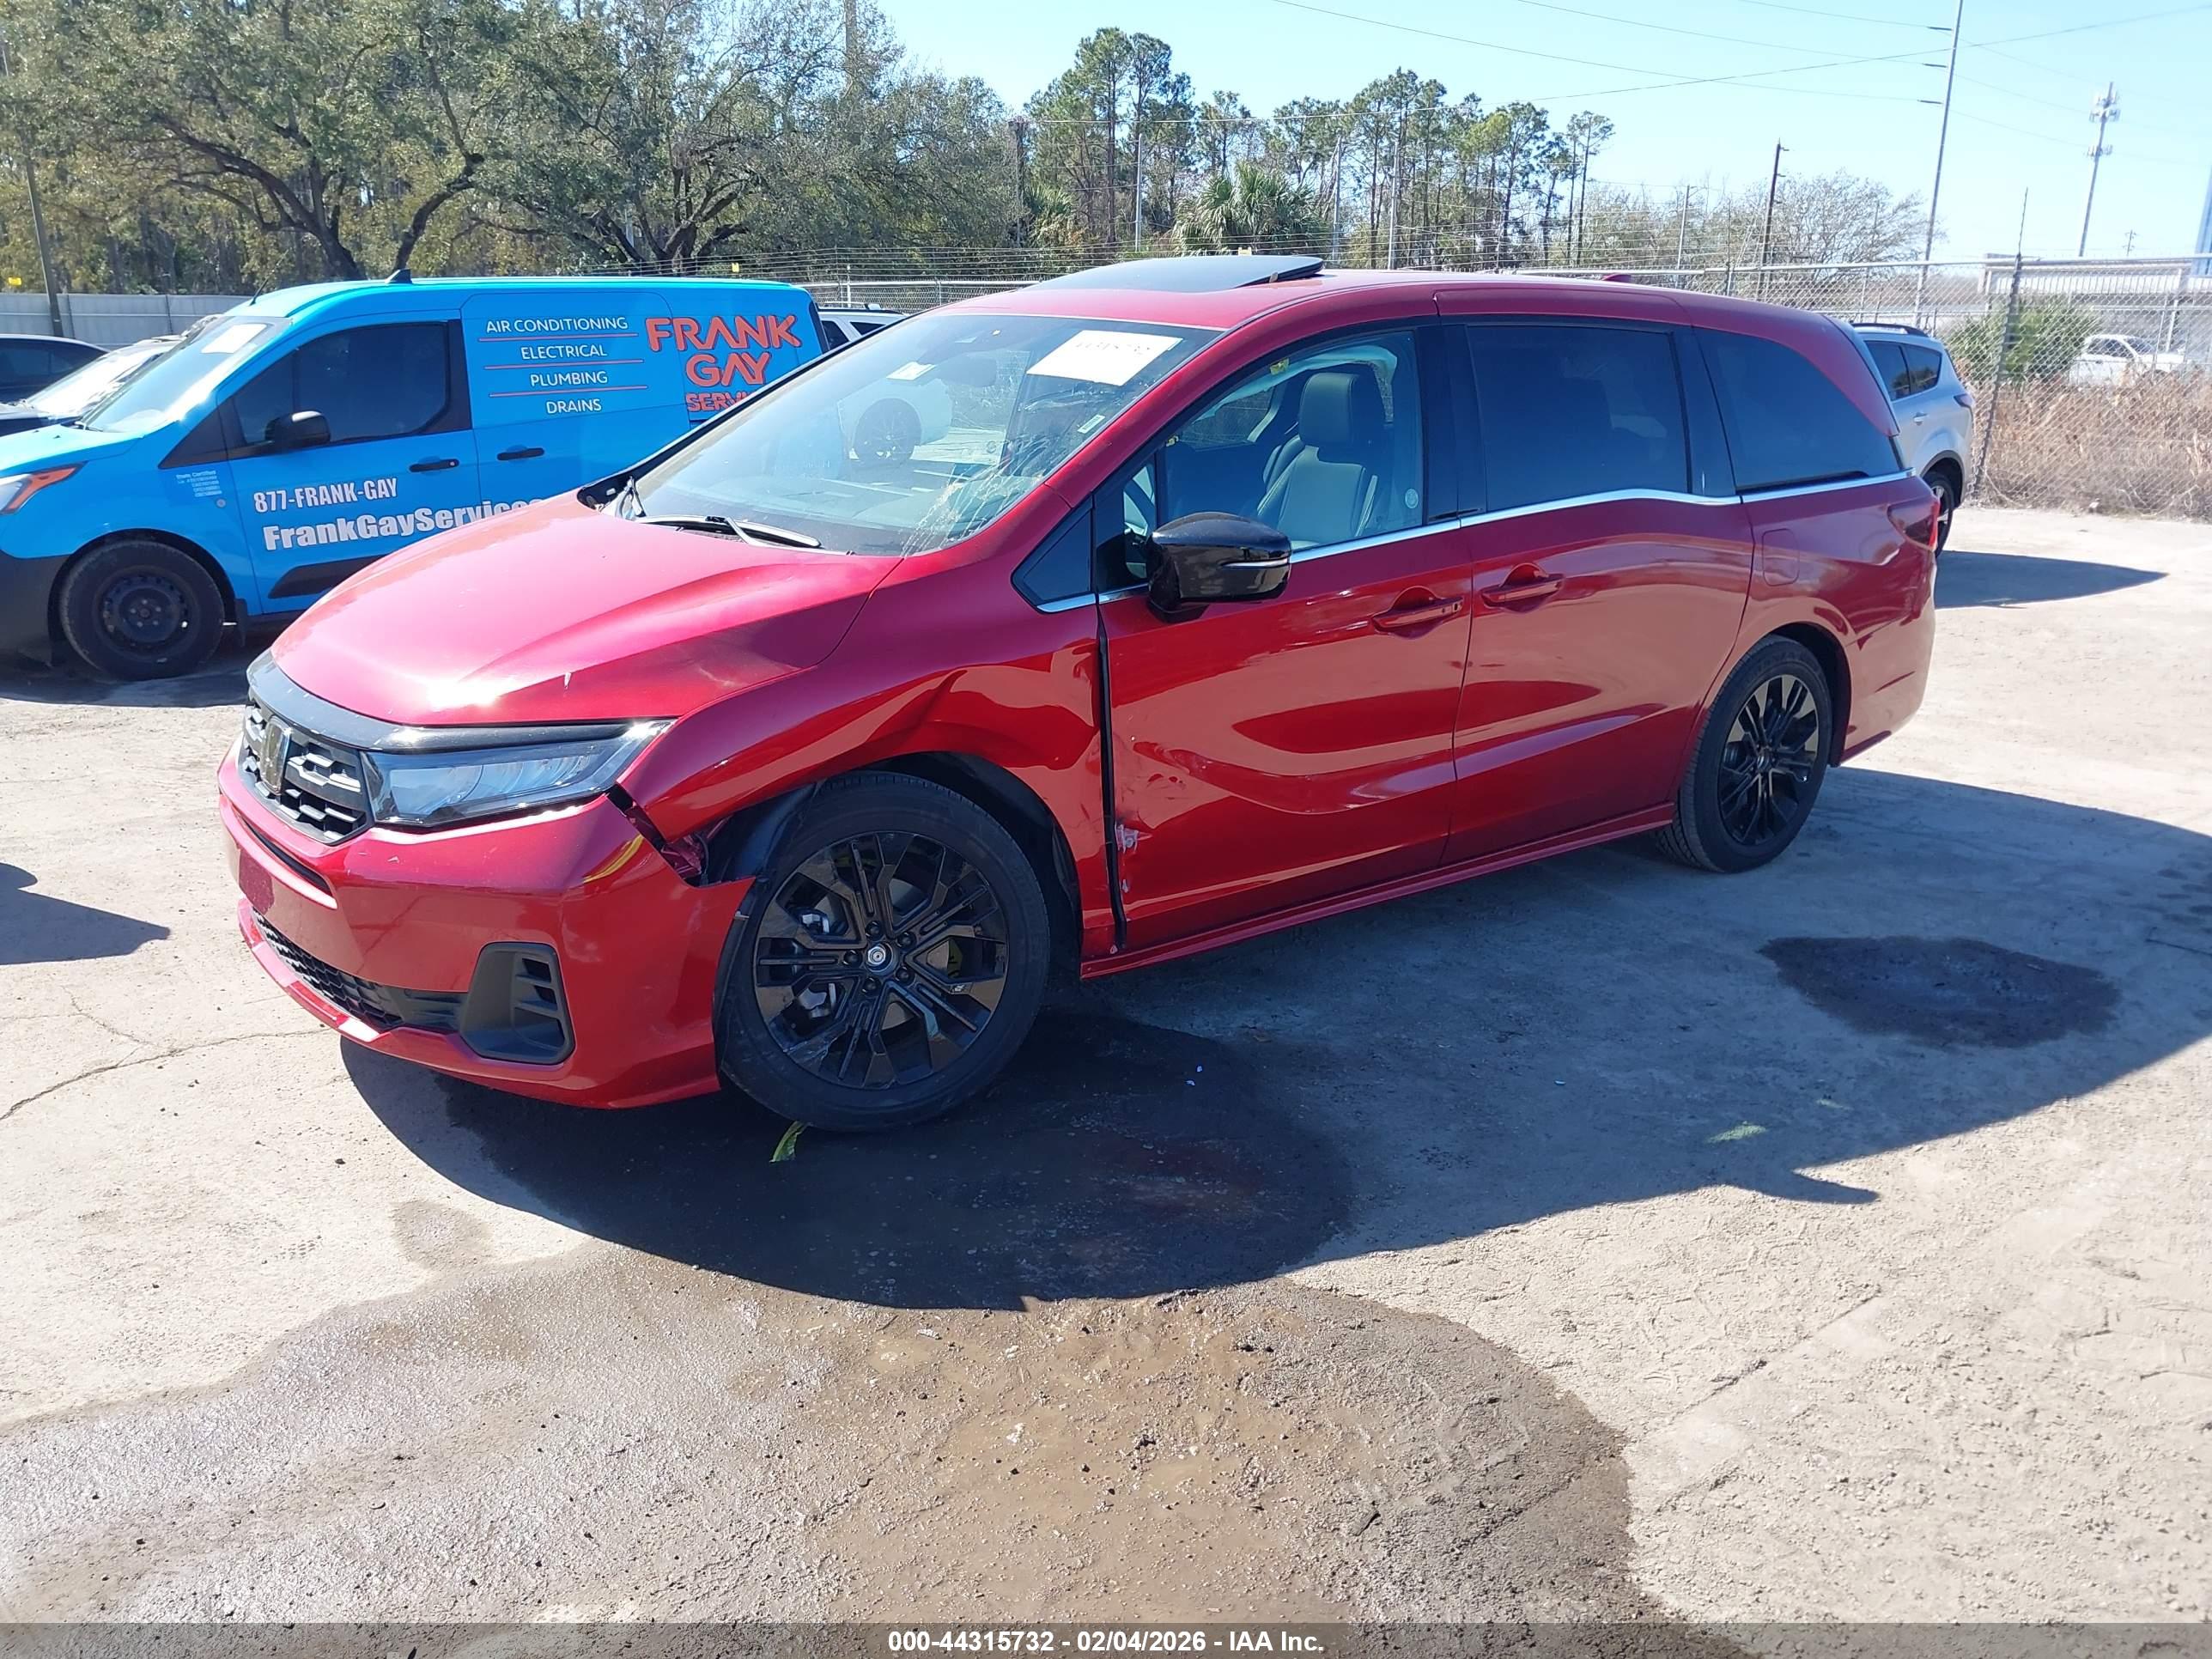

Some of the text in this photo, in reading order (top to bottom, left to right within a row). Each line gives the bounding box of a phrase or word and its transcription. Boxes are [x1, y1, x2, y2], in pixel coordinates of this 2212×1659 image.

[486, 317, 629, 333] AIR CONDITIONING
[646, 315, 802, 352] FRANK
[520, 343, 608, 360] ELECTRICAL
[686, 352, 770, 386] GAY
[530, 371, 608, 386] PLUMBING
[546, 398, 602, 414] DRAINS
[253, 477, 398, 513] 877-FRANK-GAY
